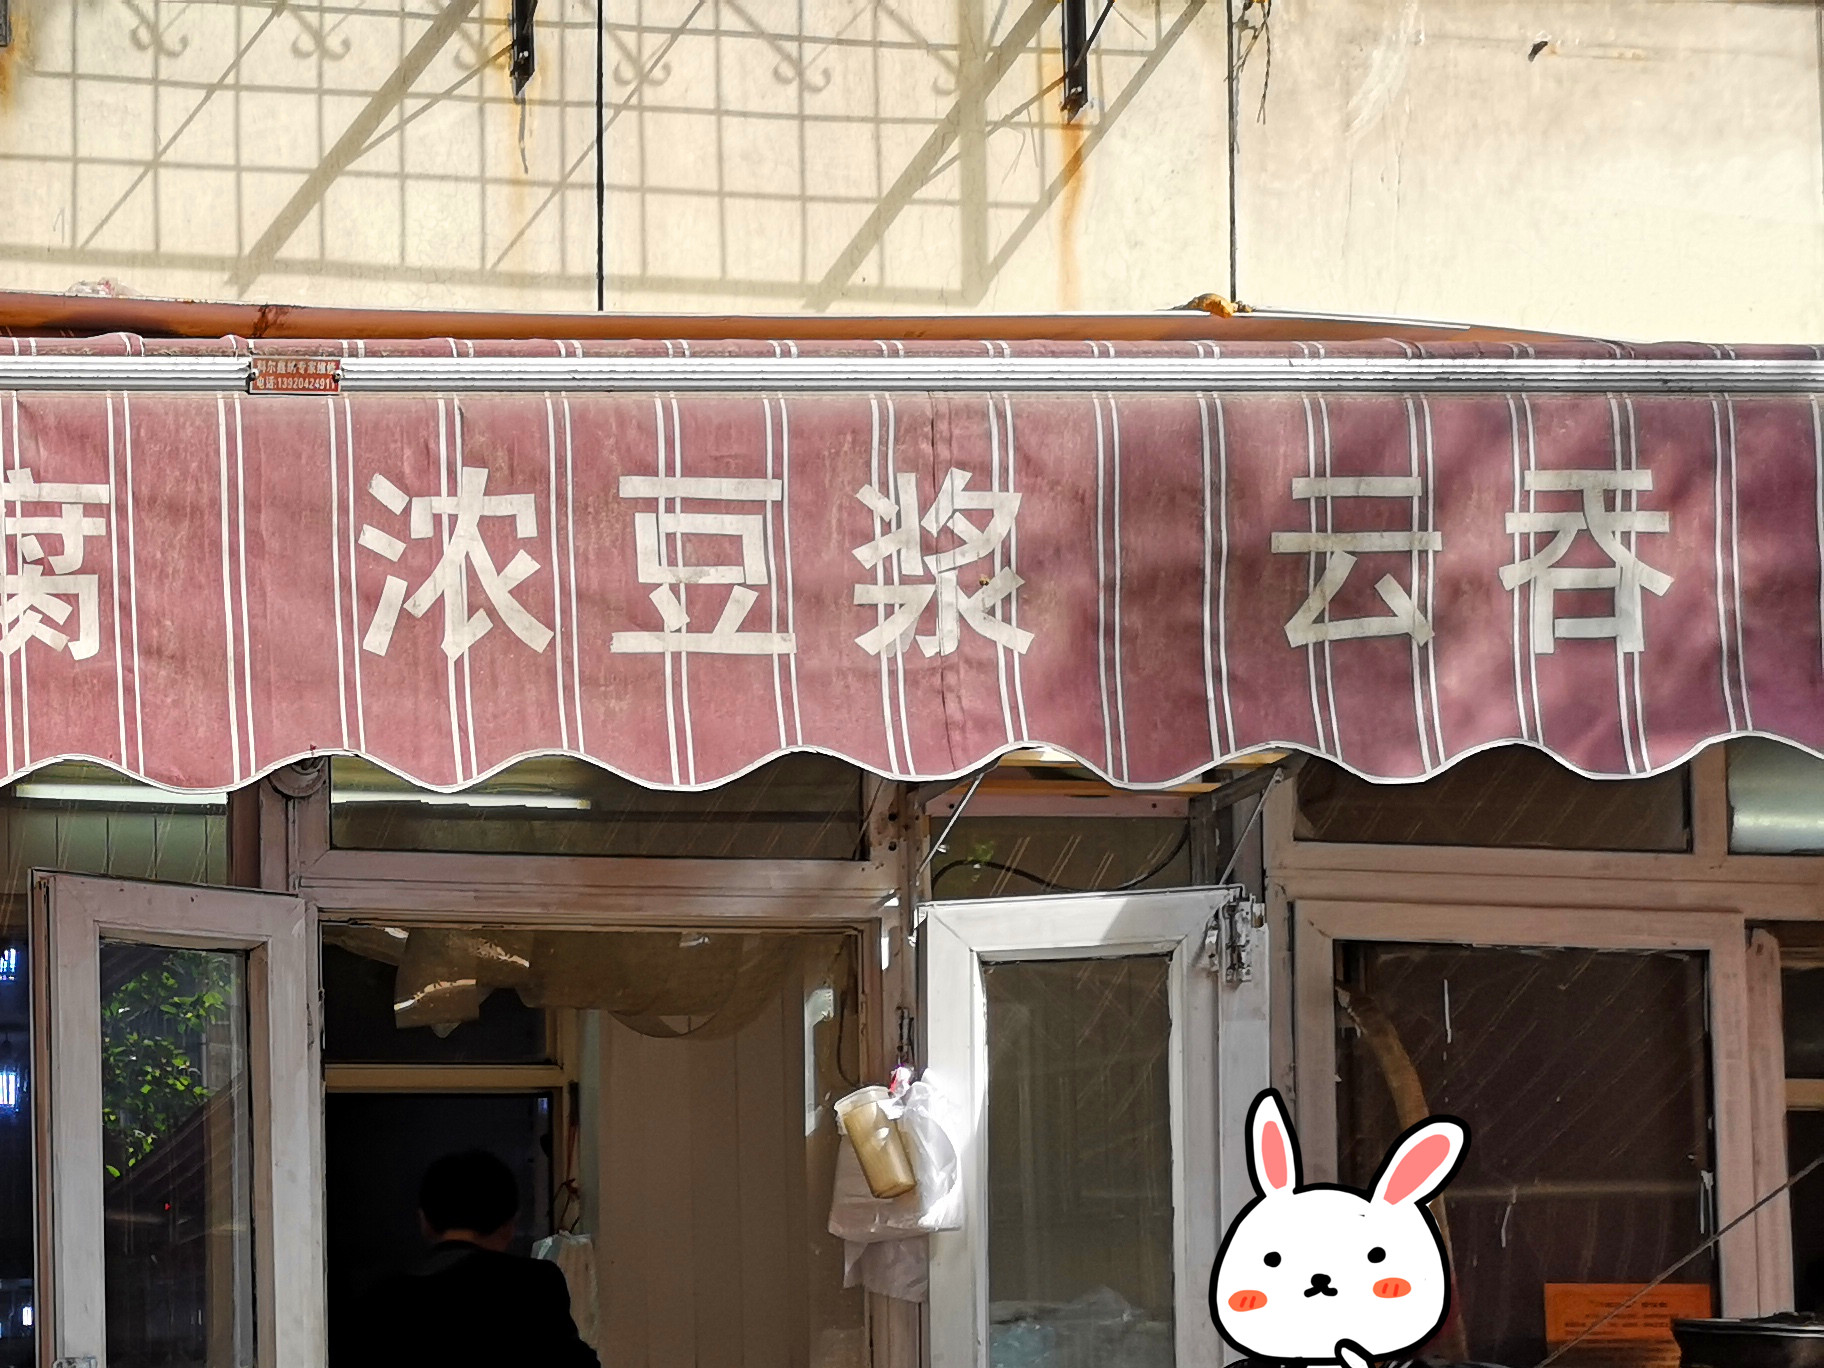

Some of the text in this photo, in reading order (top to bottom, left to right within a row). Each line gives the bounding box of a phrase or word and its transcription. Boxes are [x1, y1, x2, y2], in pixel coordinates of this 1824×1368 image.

[360, 465, 1036, 660] 浓豆浆
[1269, 468, 1674, 655] 云吞
